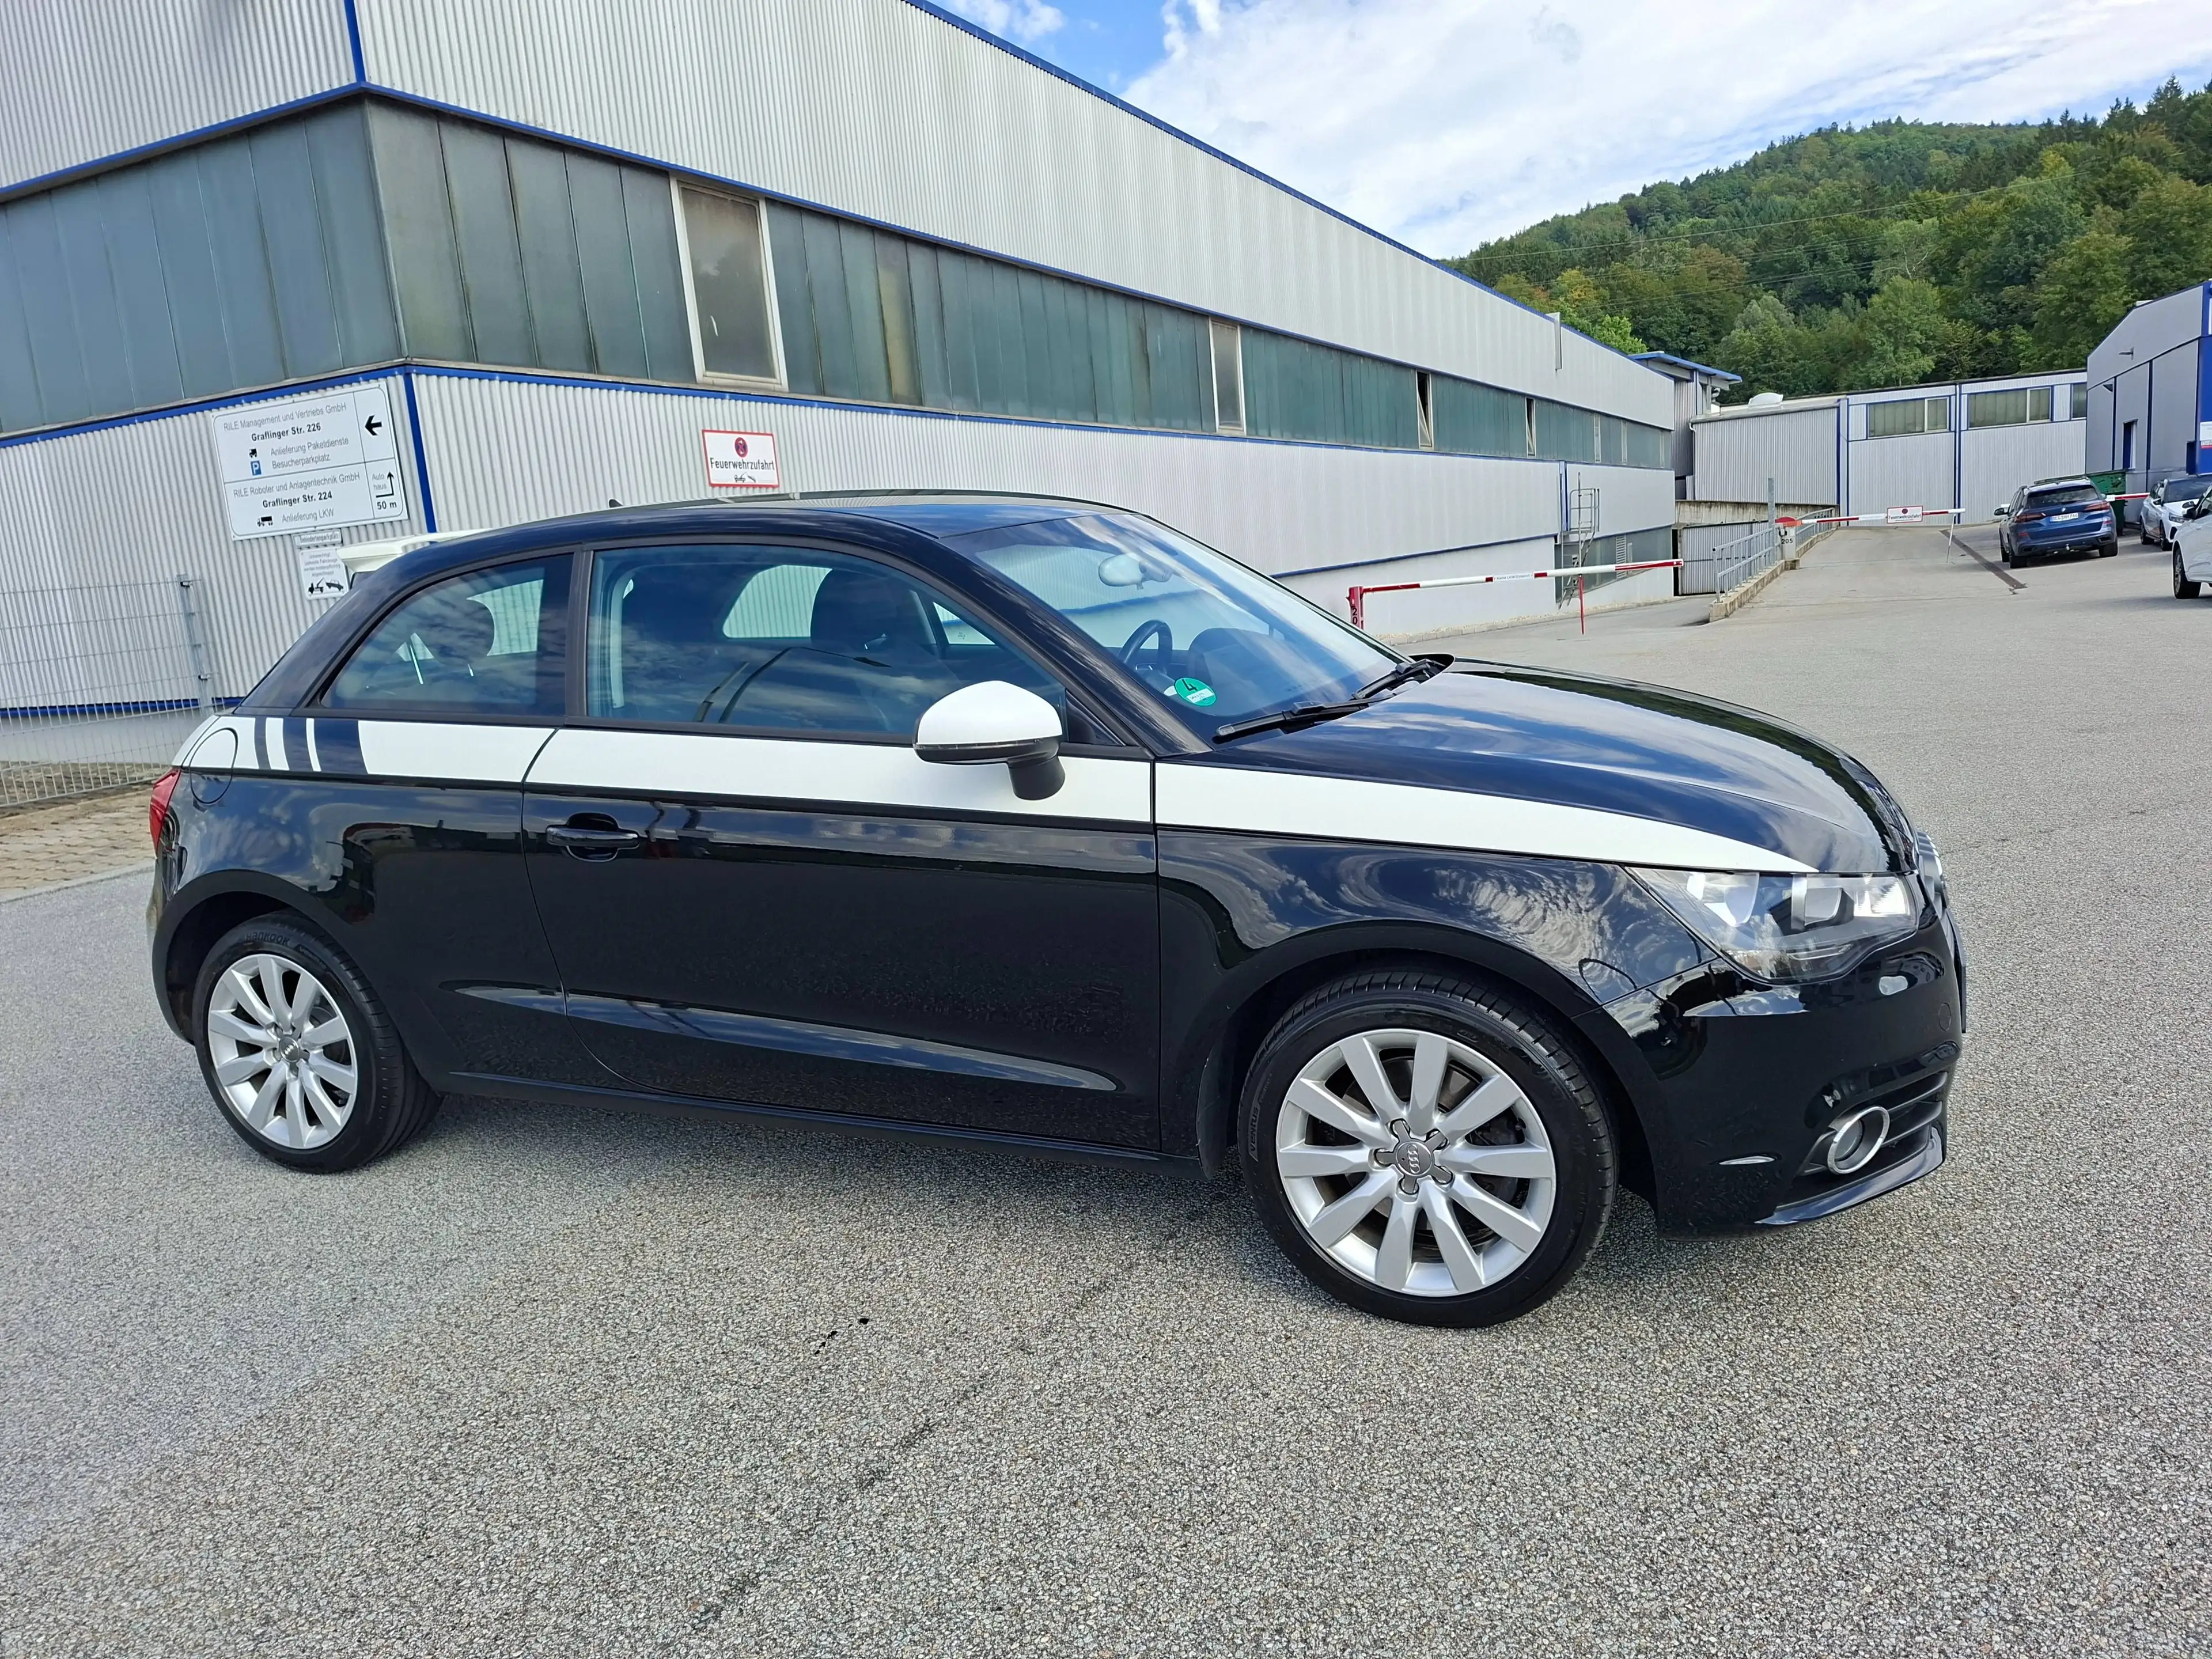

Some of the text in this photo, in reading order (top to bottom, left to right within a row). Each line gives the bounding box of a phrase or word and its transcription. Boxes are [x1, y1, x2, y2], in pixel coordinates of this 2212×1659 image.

[224, 403, 347, 431] RILE Management und Vertriebs GmbH
[251, 422, 321, 442] Graflinger Str. 226
[271, 437, 349, 456] Anlieferung Paketdienste
[272, 453, 331, 469] Besucherparkplatz
[710, 457, 775, 471] Feuerwehrzufahrt
[233, 471, 360, 498] RILE Roboter und Anlagentechnik GmbH
[372, 473, 385, 481] Auto
[262, 491, 332, 509] Graflinger Str. 224
[377, 501, 387, 510] 50
[282, 508, 334, 523] Anlieferung LKW
[1181, 679, 1198, 691] 4
